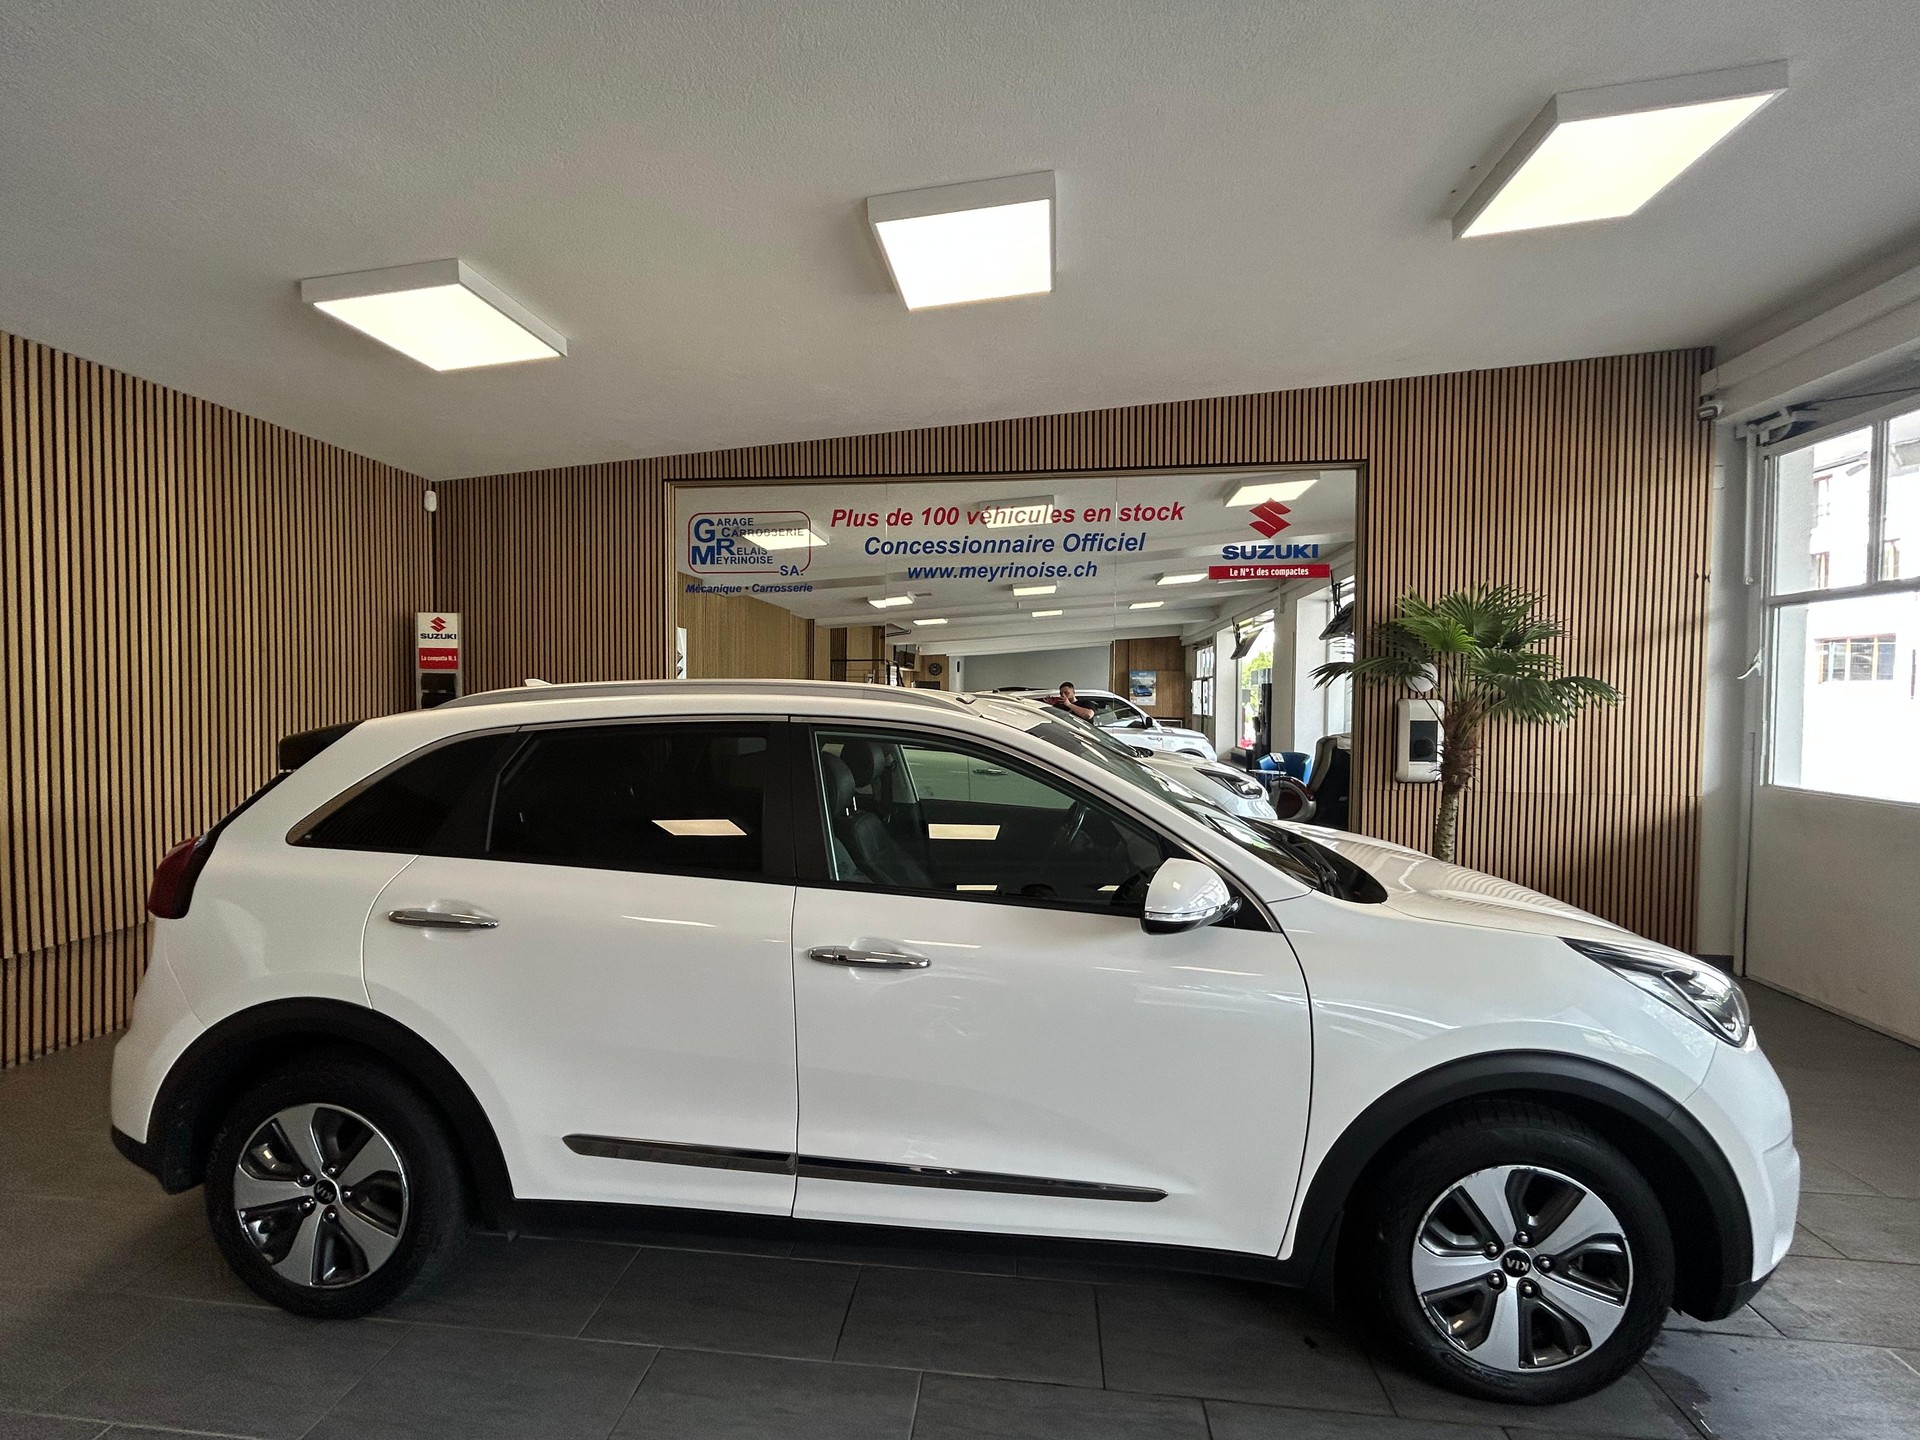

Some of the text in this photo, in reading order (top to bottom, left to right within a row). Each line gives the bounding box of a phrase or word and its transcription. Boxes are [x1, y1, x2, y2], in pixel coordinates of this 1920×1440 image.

[831, 501, 1186, 527] Plus de 100 véhicules en stock
[864, 532, 1147, 556] Concessionnaire Officiel
[1222, 544, 1319, 560] SUZUKI
[907, 560, 1098, 582] www.meyrinoise.ch
[1229, 568, 1239, 577] Le
[1256, 567, 1270, 577] des
[1271, 567, 1309, 578] compactes
[685, 582, 814, 594] Mécanique Carrosserie
[1506, 1257, 1530, 1272] KIA
